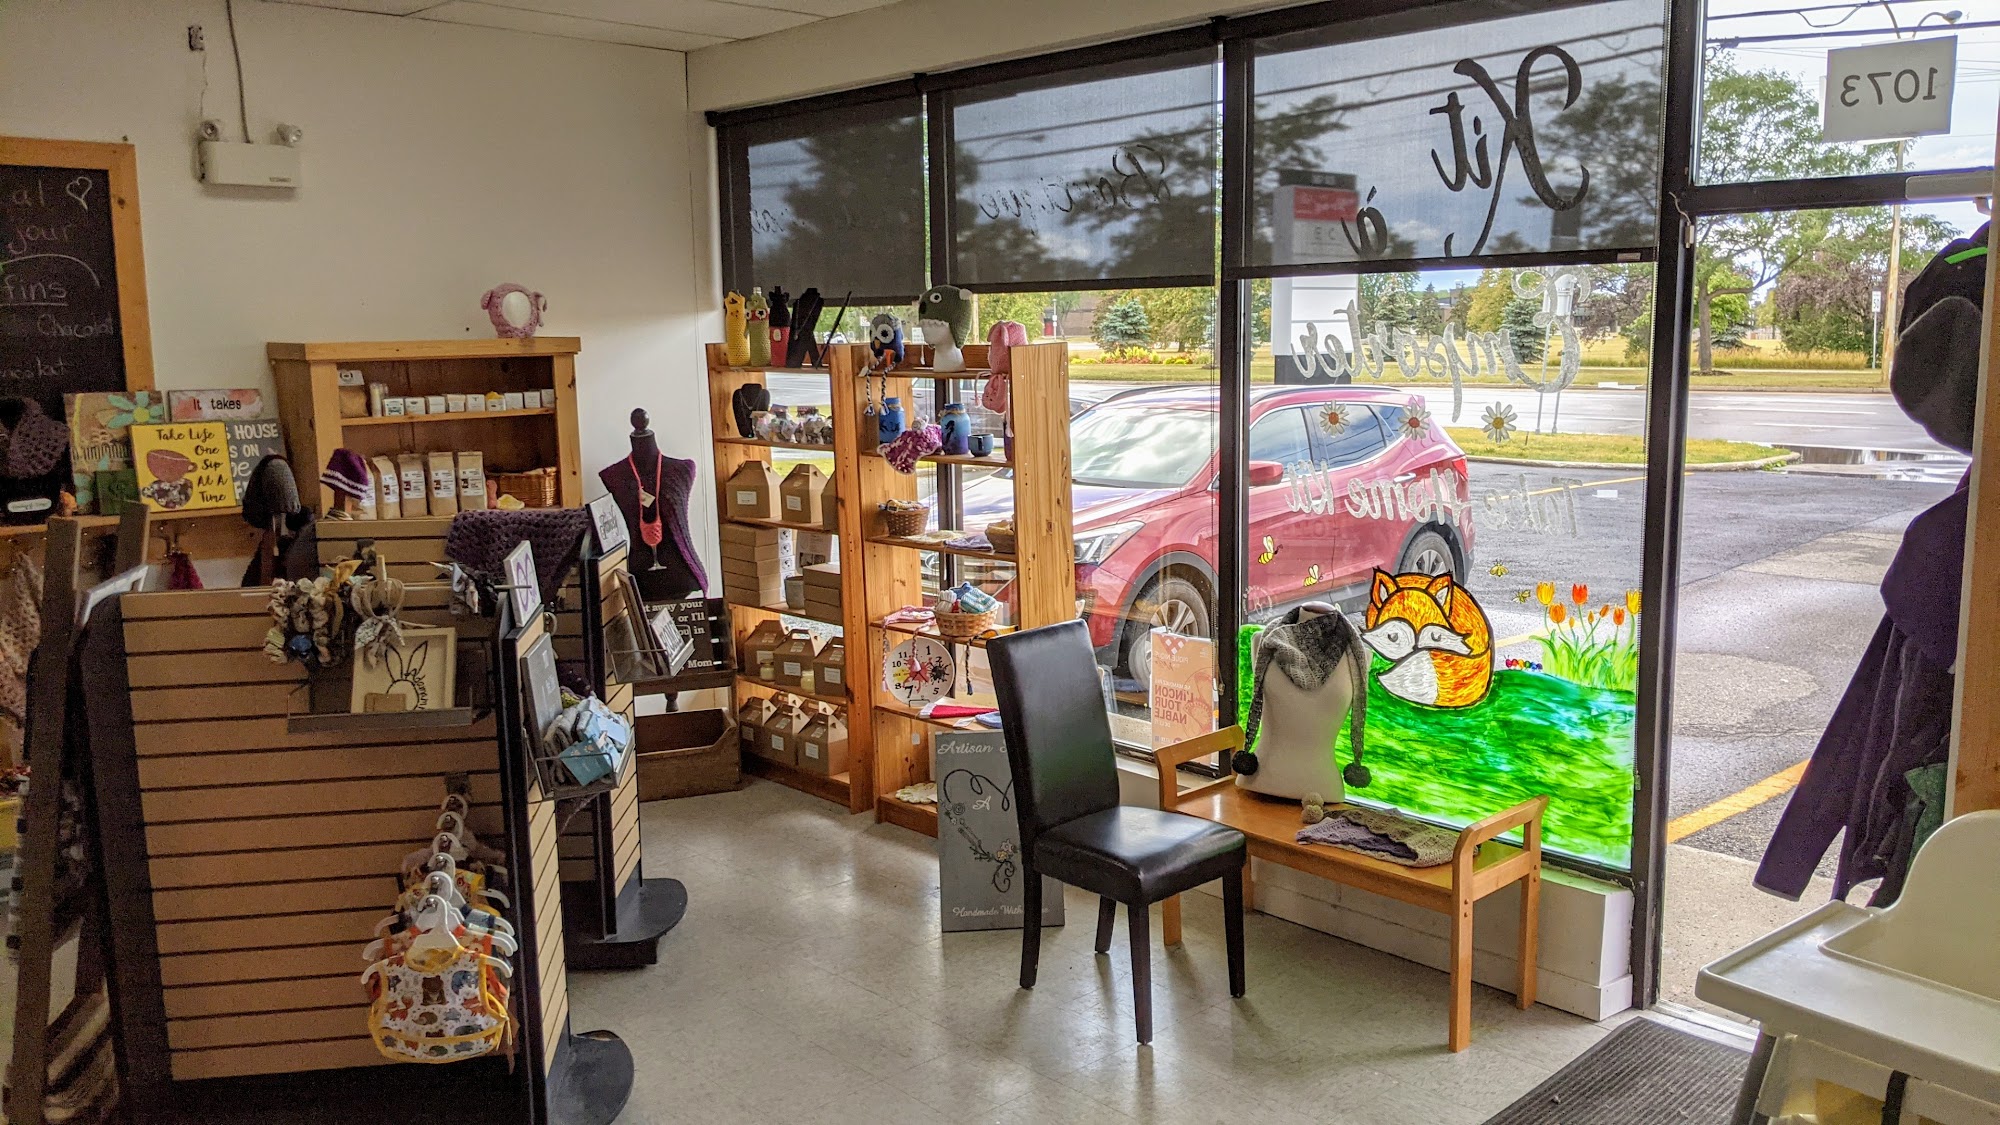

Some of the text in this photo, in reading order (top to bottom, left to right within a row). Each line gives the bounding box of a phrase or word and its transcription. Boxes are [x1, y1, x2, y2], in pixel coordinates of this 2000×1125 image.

[193, 398, 242, 411] It takes
[156, 429, 185, 441] Take
[189, 428, 215, 443] Life
[234, 423, 279, 440] HOUSE
[194, 445, 220, 456] One
[243, 444, 260, 457] ON
[201, 459, 223, 472] Sip
[197, 474, 228, 487] At A
[198, 491, 226, 503] Time
[680, 601, 704, 611] your
[691, 612, 705, 621] I'll
[693, 626, 705, 635] in
[926, 645, 931, 655] 1
[688, 660, 713, 668] Mom
[905, 685, 913, 698] 7
[933, 687, 940, 695] 5
[937, 740, 994, 754] Artisan
[952, 905, 1024, 917] Handmade With
